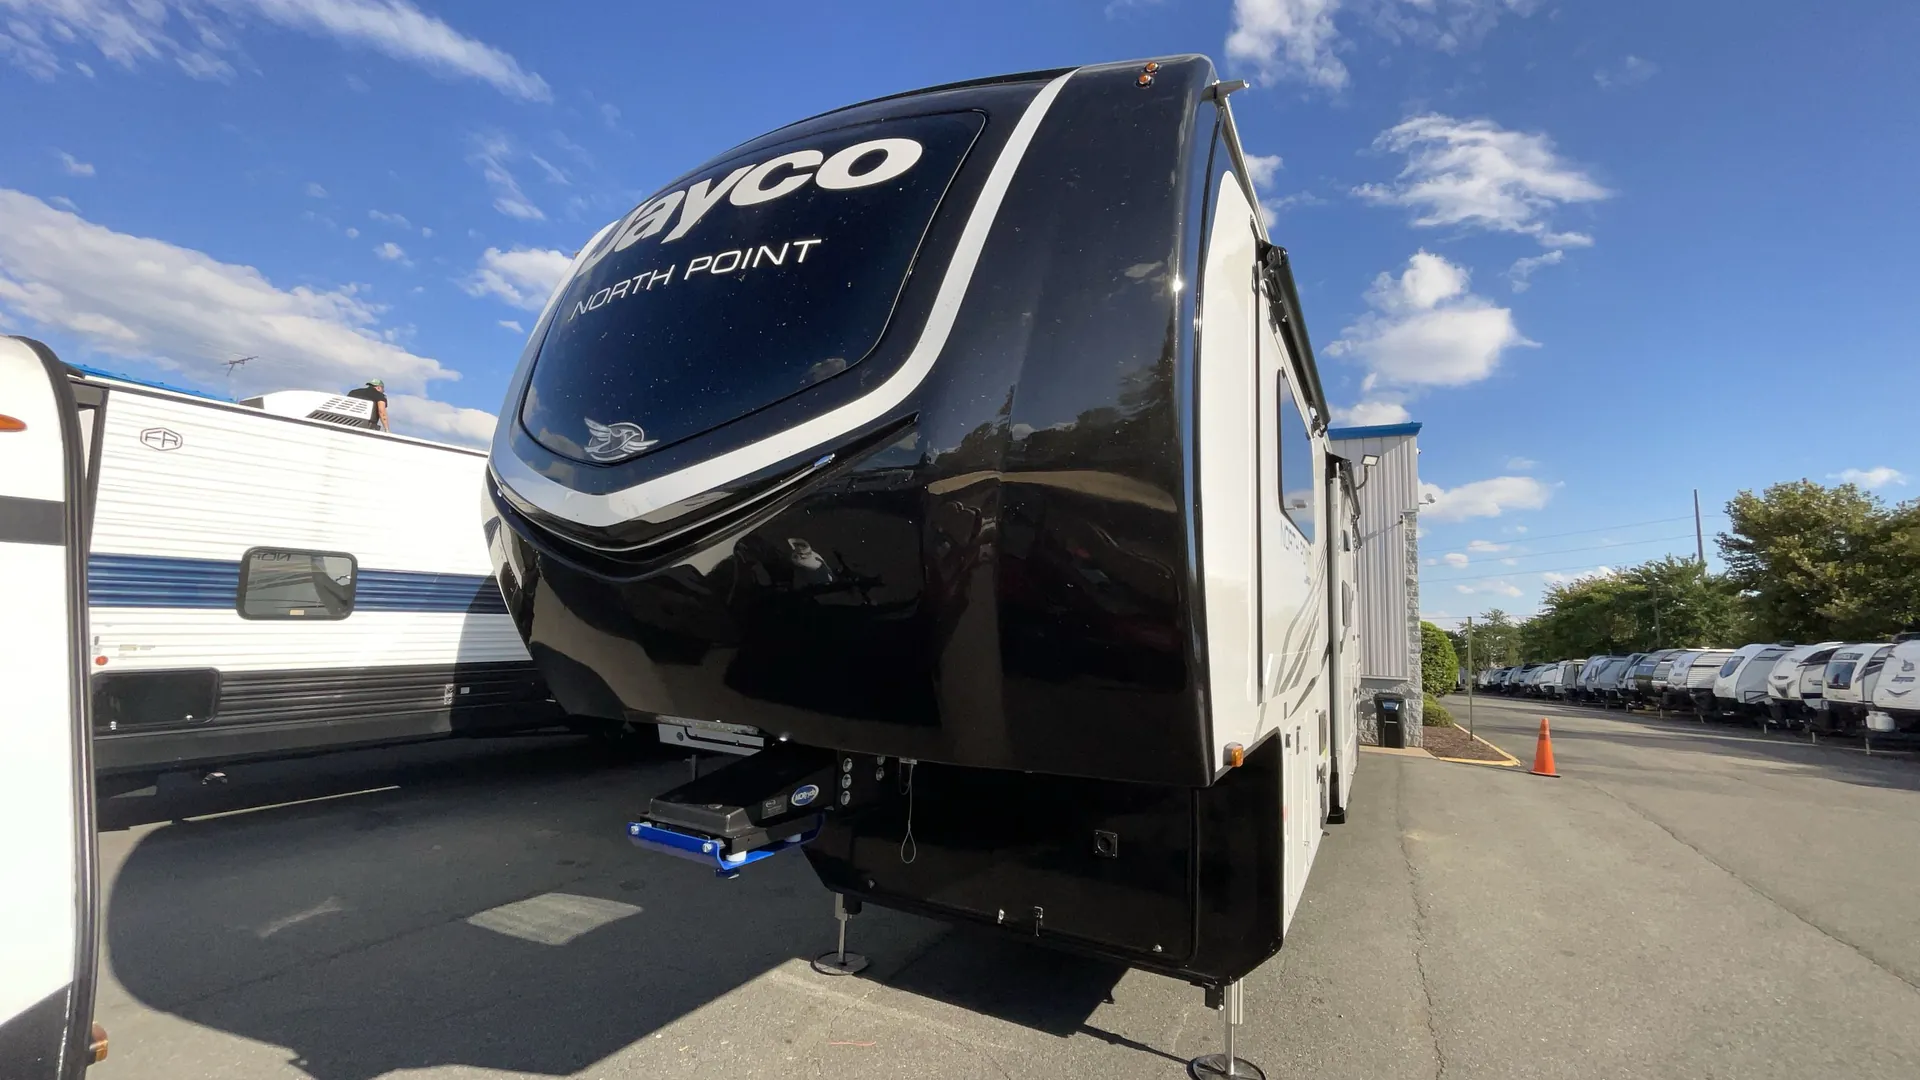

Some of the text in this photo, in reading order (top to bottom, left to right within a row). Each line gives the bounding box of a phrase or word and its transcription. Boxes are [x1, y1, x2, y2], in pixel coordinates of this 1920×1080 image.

[568, 239, 822, 322] NORTH POINT
[145, 430, 179, 448] FR
